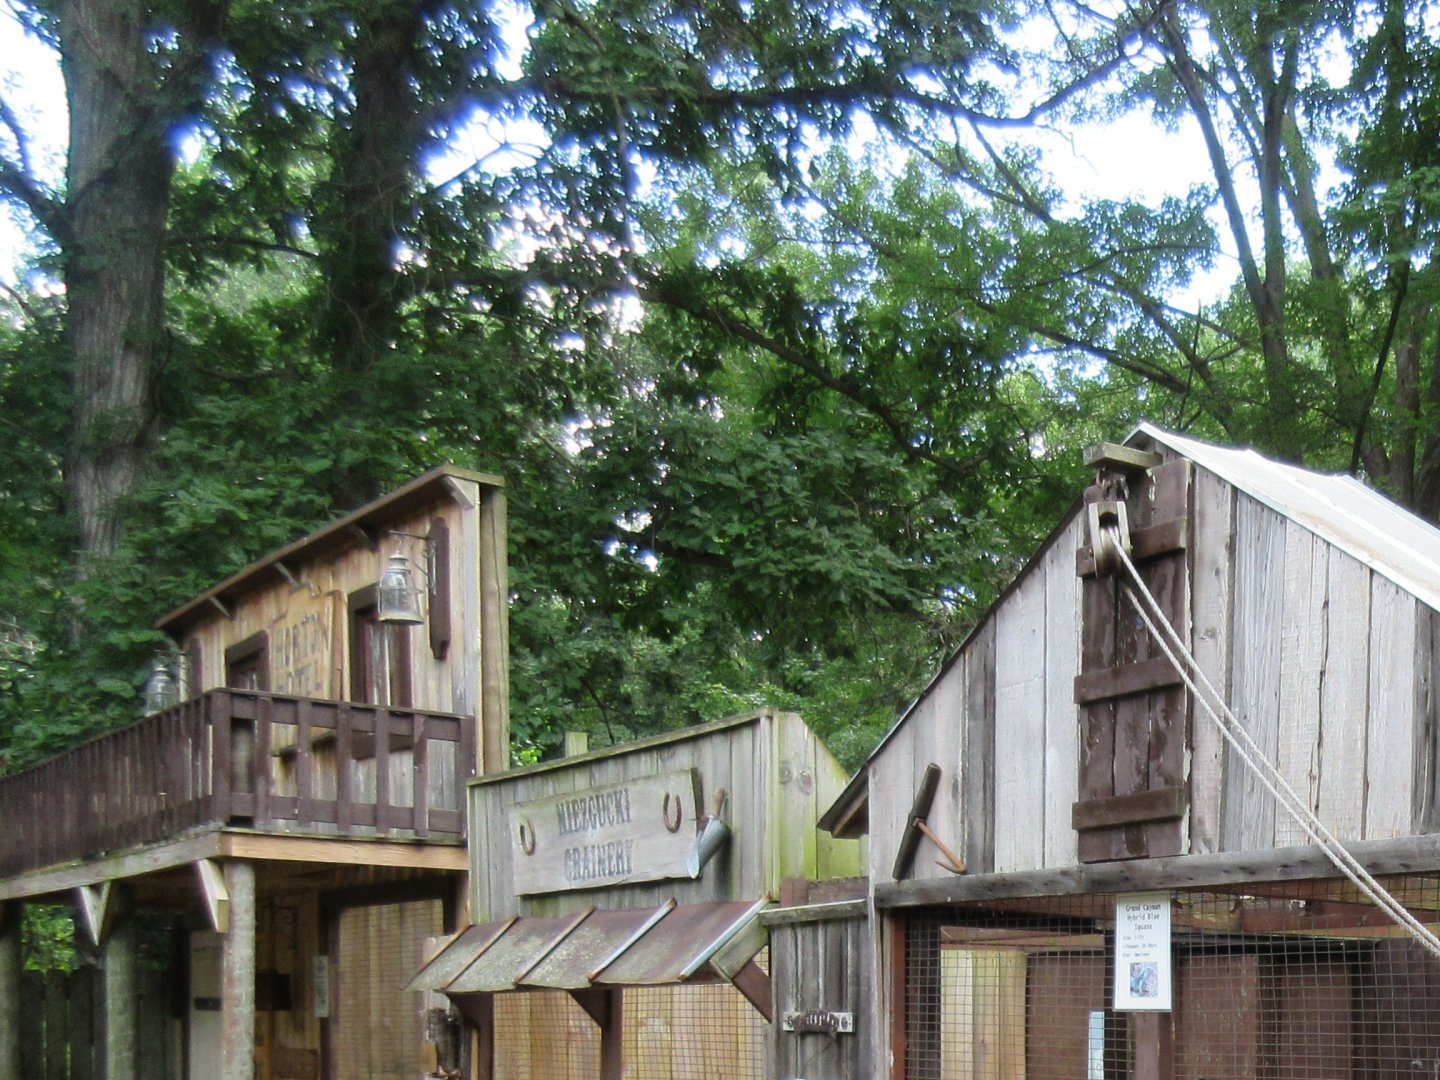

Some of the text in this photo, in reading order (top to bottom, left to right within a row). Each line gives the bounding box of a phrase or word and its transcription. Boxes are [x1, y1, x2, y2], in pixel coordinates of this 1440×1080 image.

[564, 838, 635, 883] GRAINERY
[1125, 903, 1162, 912] Grand Cayman
[1127, 912, 1160, 922] Hybrid Blue
[1134, 923, 1153, 931] Iguana
